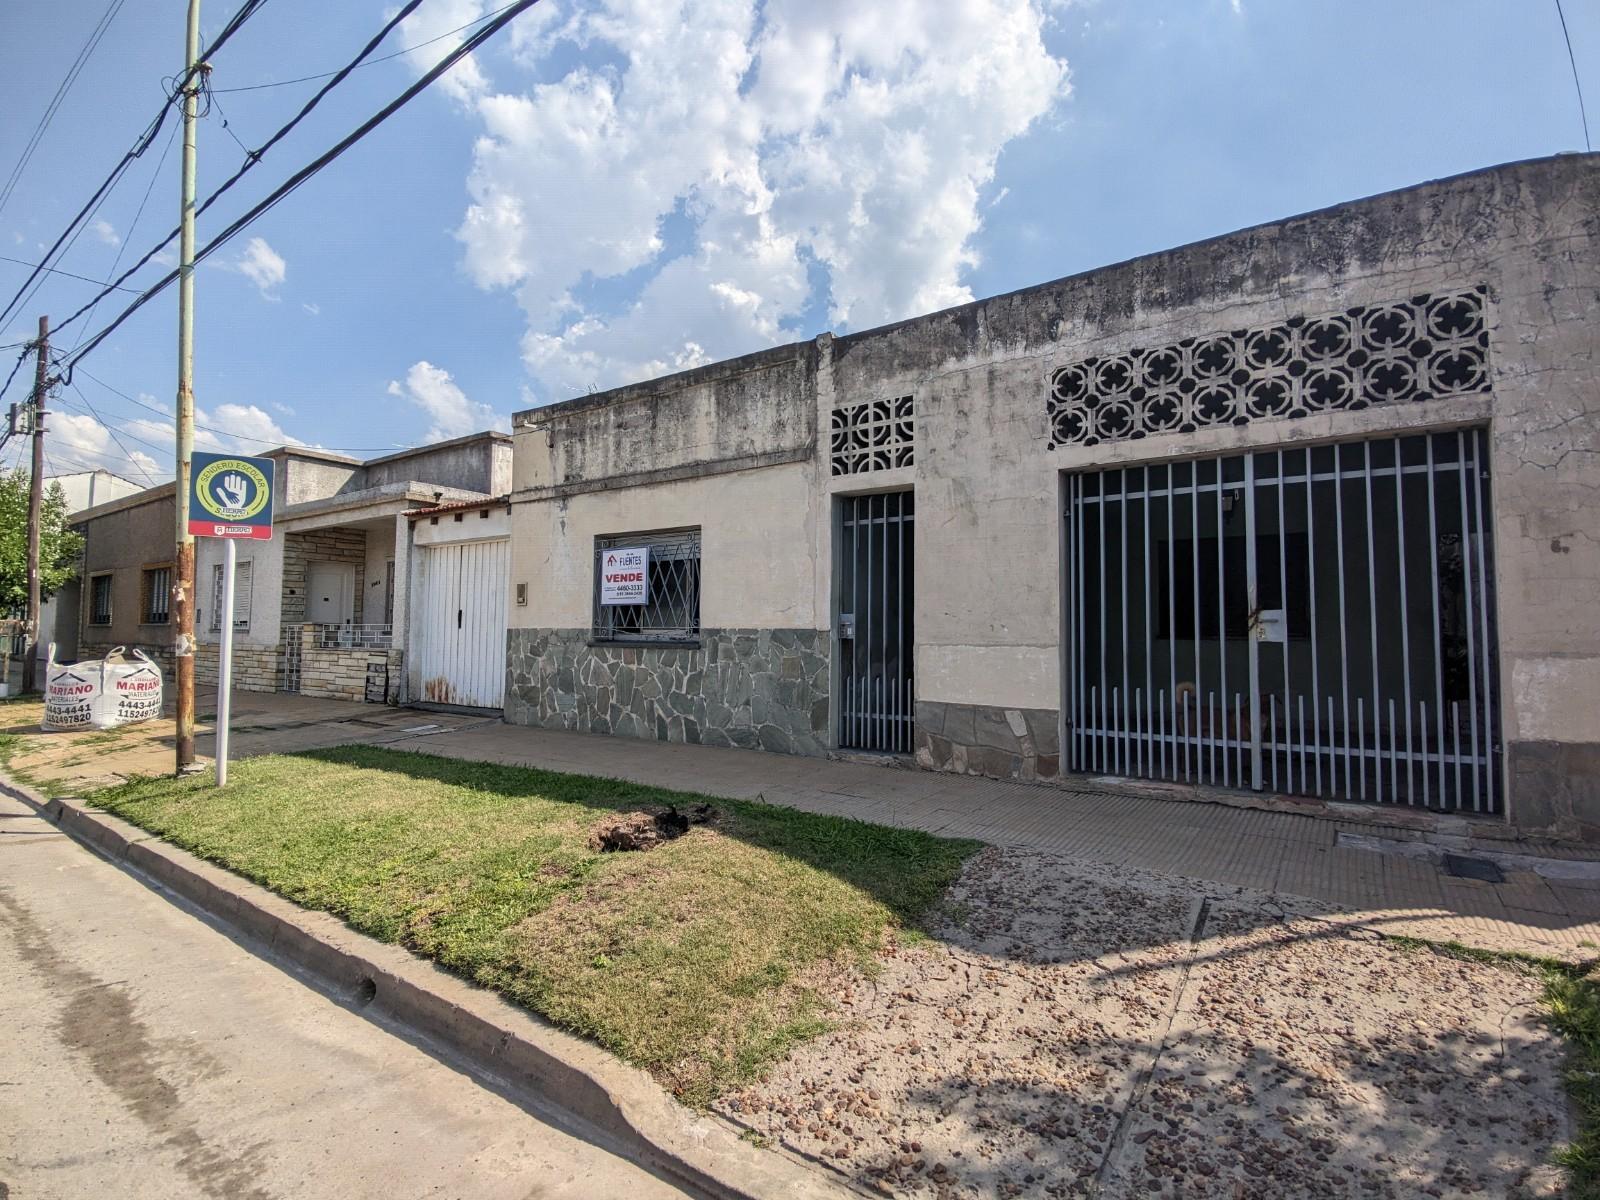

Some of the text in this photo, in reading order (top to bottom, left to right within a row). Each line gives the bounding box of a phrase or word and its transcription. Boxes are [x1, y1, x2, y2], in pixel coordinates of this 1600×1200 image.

[201, 462, 266, 488] SENDERO ESCOLAR
[605, 573, 643, 583] VENDE
[46, 704, 92, 715] 4443-4441
